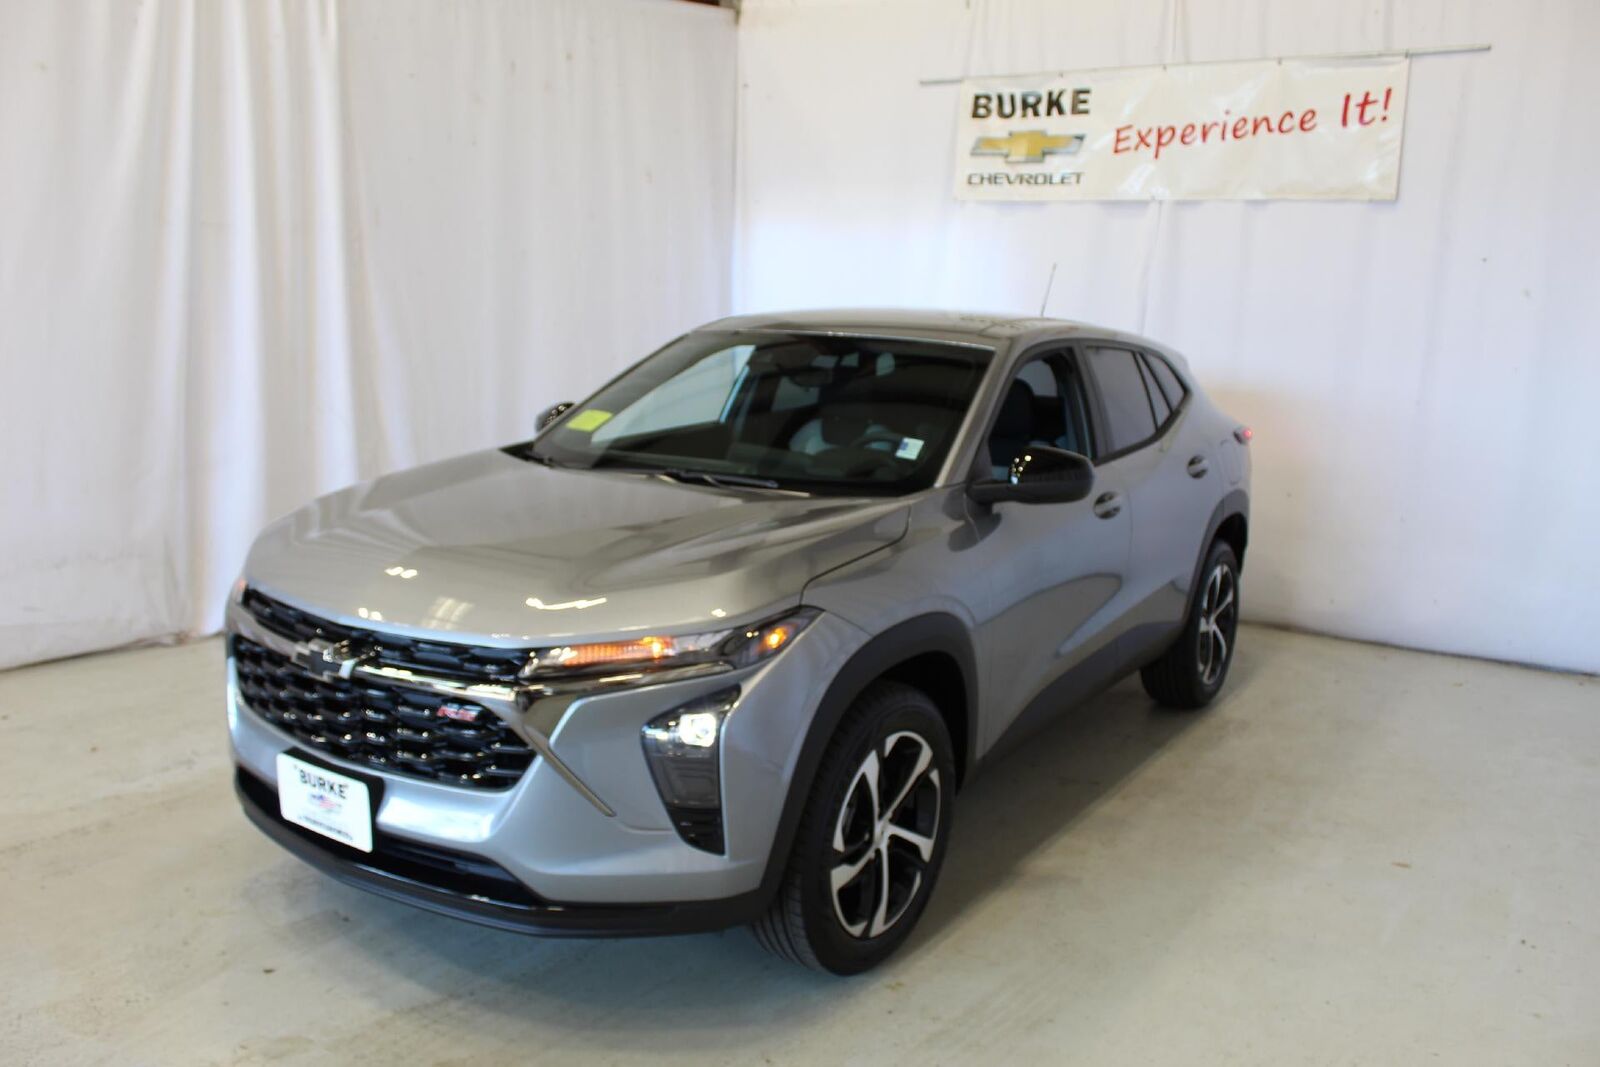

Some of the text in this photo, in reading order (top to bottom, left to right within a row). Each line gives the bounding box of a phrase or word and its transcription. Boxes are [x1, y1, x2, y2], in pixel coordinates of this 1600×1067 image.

[971, 88, 1091, 119] BURKE
[1112, 87, 1393, 159] Experience It!
[967, 172, 1085, 186] CHEVROLET
[299, 768, 348, 800] BURKE
